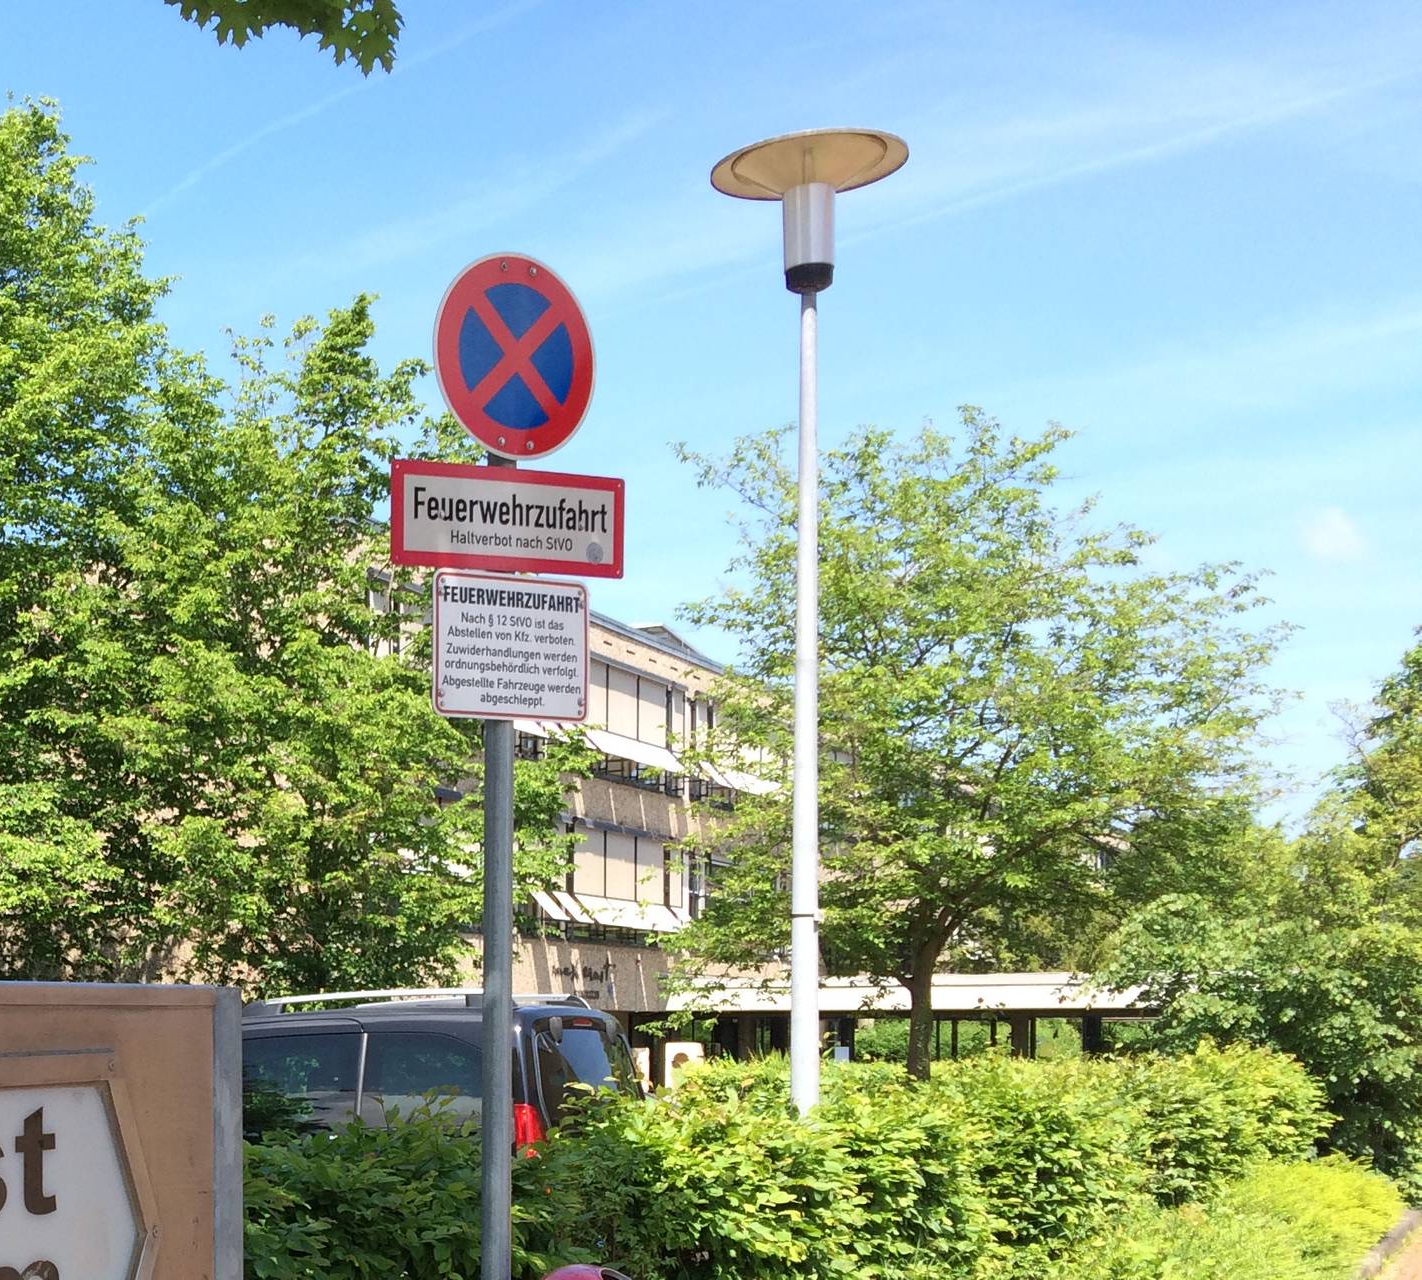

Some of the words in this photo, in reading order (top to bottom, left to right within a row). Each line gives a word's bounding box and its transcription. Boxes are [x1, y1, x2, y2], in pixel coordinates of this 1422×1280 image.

[413, 486, 607, 533] Feuerwehrzufahrt
[450, 530, 512, 548] Haltverbot
[516, 537, 543, 550] nach
[546, 536, 573, 551] StVO
[443, 586, 580, 613] FEUERWEHRZUFAHRT
[461, 612, 485, 625] Nach
[488, 614, 494, 627] §
[497, 615, 509, 627] 12
[510, 616, 532, 628] StVO
[534, 618, 545, 629] ist
[548, 618, 564, 631] das
[447, 626, 492, 640] Abstellen
[495, 631, 511, 641] von
[514, 631, 532, 643] Kfz.
[534, 633, 575, 646] verboten.
[446, 643, 541, 662] Zuwiderhandlungen
[543, 649, 577, 663] werden
[444, 659, 539, 674] ordnungsbehördlich
[542, 665, 578, 679] verfolgt.
[442, 675, 495, 689] Abgestellte
[497, 678, 545, 694] Fahrzeuge
[548, 681, 581, 694] werden
[480, 693, 545, 708] abgeschleppt.
